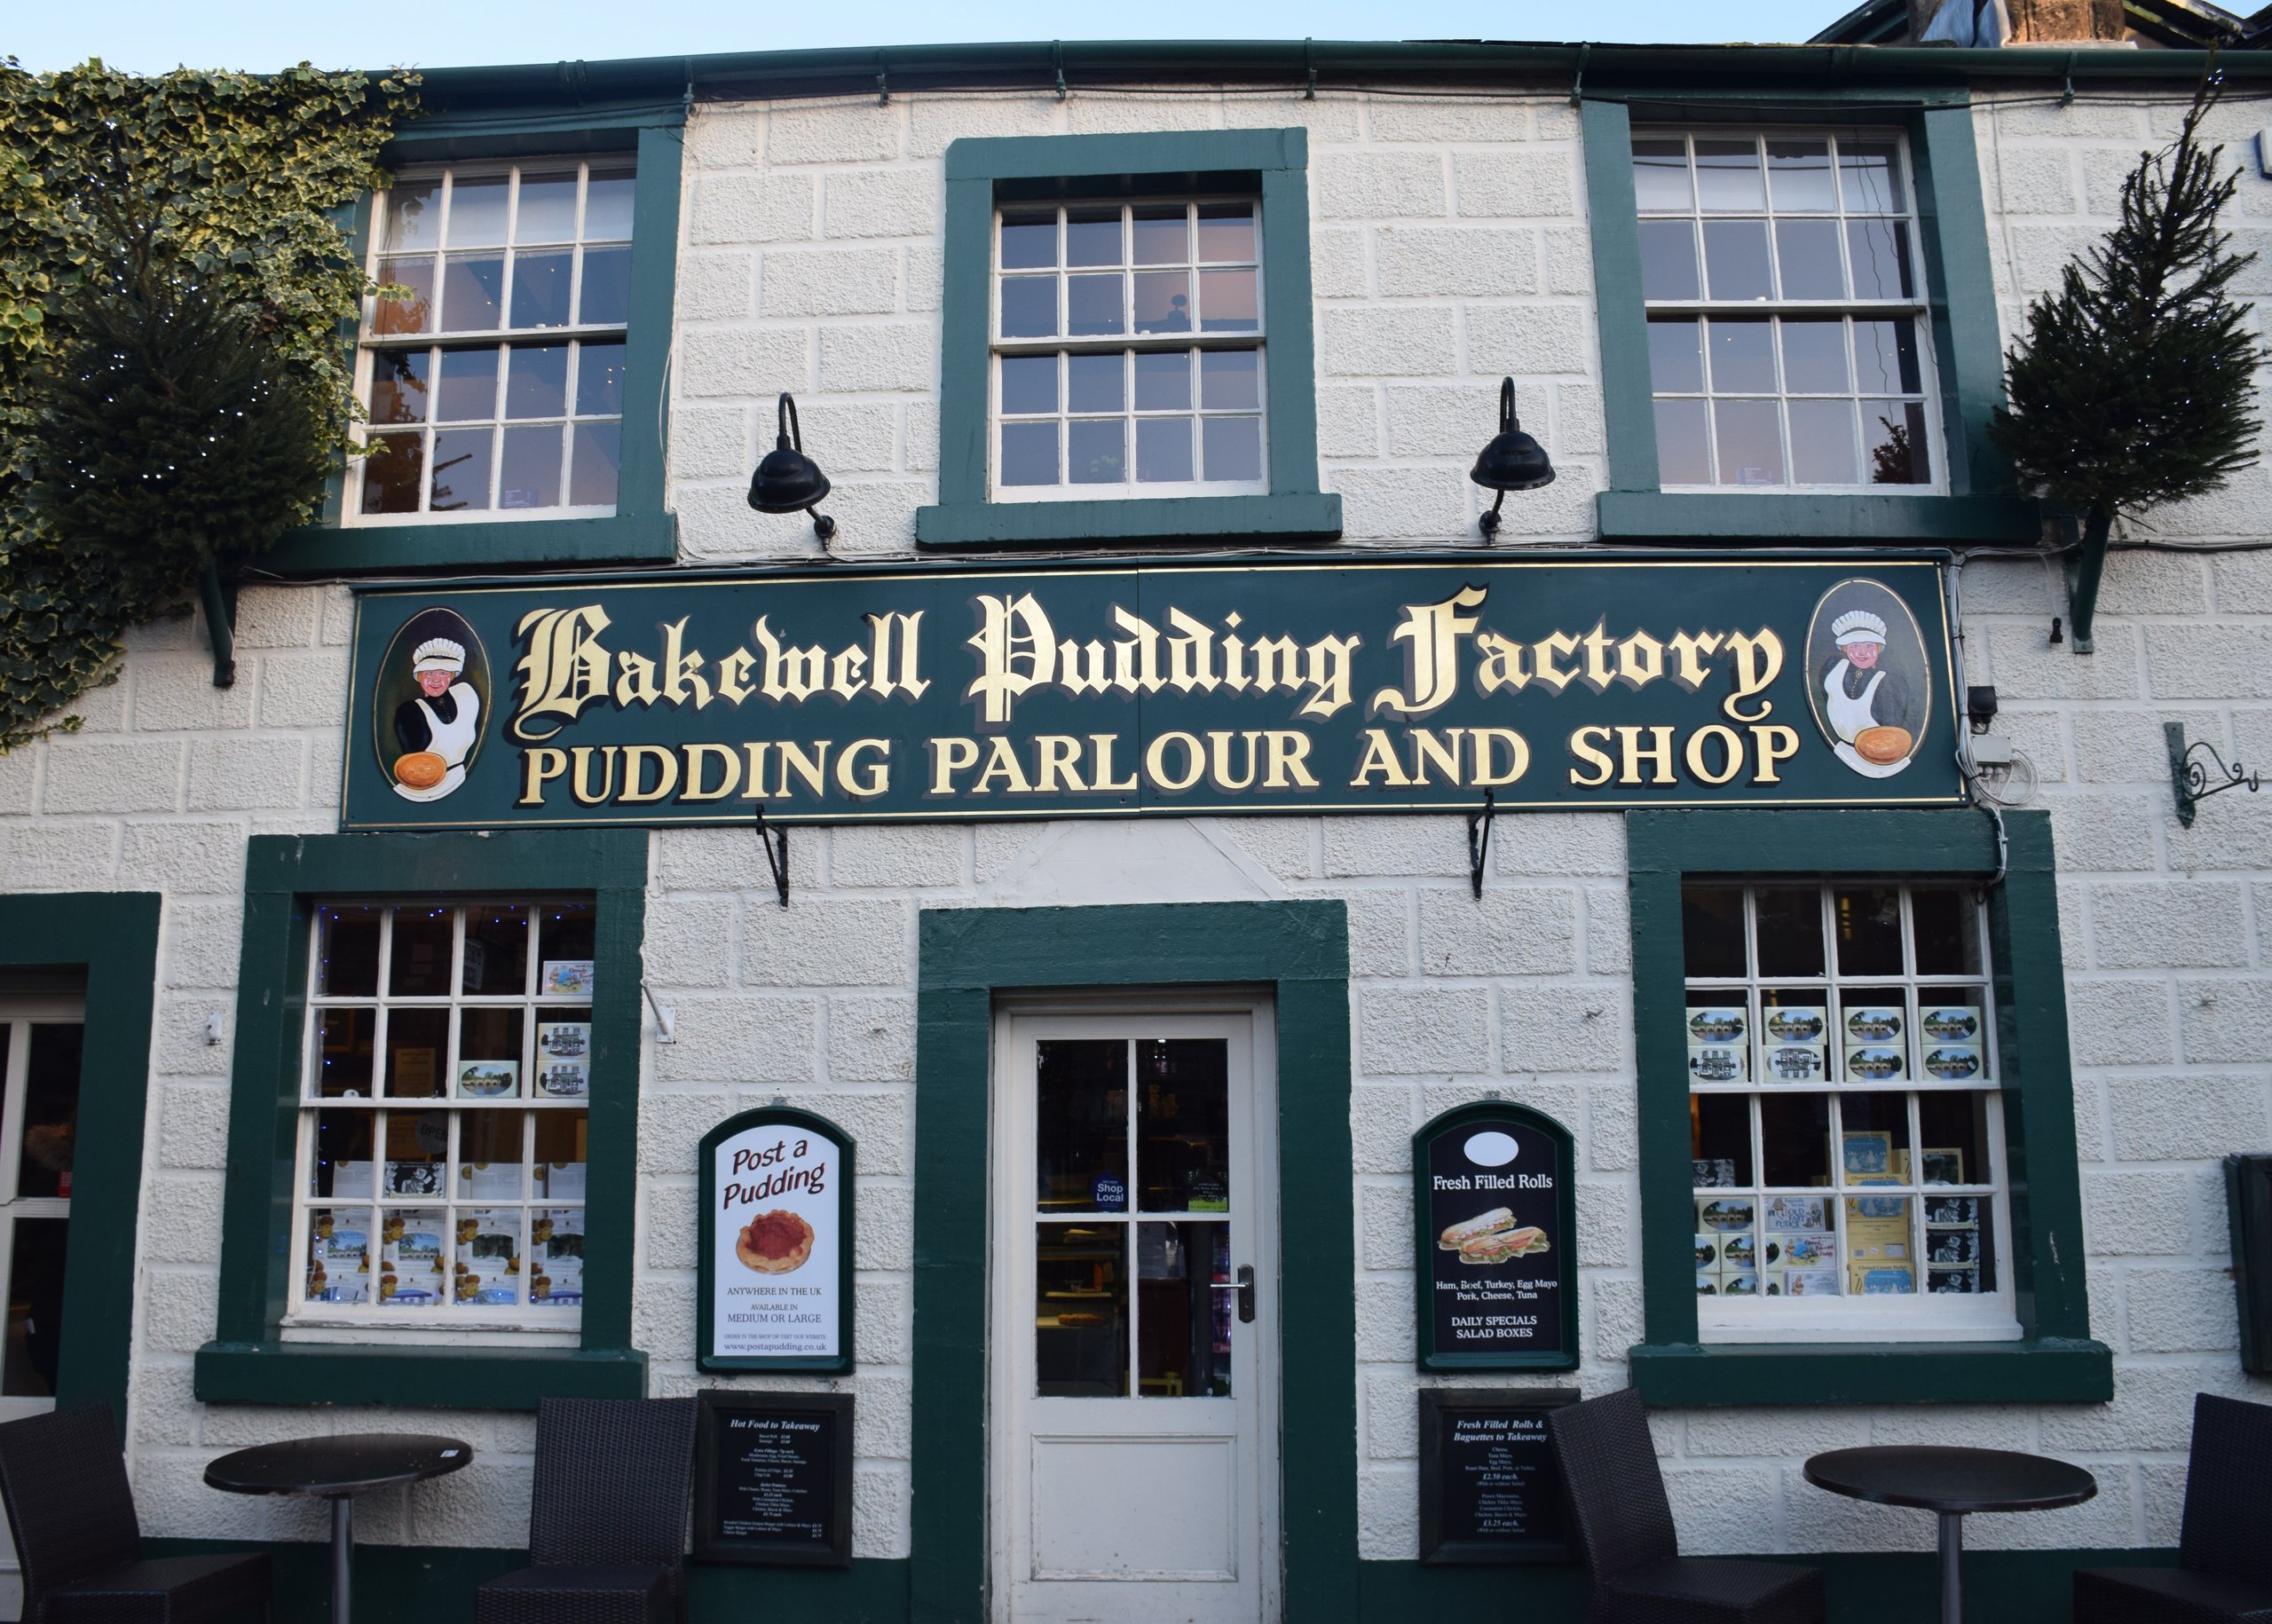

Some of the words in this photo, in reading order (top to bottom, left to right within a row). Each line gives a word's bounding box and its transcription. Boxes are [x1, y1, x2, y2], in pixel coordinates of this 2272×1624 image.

[515, 603, 932, 741] Bakewell
[966, 592, 1364, 723] Pudding
[1373, 583, 1783, 722] Factory
[519, 738, 890, 804] PUDDING
[931, 730, 1321, 795] PARLOUR
[1351, 728, 1530, 788] AND
[1569, 724, 1800, 787] SHOP
[733, 1140, 787, 1176] Post
[793, 1139, 809, 1158] a
[723, 1163, 825, 1210] Pudding
[1433, 1176, 1471, 1190] Fresh
[1475, 1175, 1515, 1189] Filled
[1519, 1174, 1553, 1188] Rolls
[1097, 1183, 1124, 1194] Shop
[1097, 1193, 1124, 1202] Local
[1436, 1281, 1459, 1291] Ham,
[1461, 1281, 1483, 1290] Beef,
[1485, 1281, 1516, 1291] Turkey,
[1518, 1281, 1534, 1290] Egg
[1535, 1280, 1558, 1289] Mayo
[1457, 1292, 1479, 1301] Pork,
[1481, 1291, 1515, 1301] Cheese,
[728, 1314, 768, 1323] MEDIUM
[771, 1314, 785, 1323] OR
[788, 1314, 822, 1323] LARGE
[1452, 1317, 1484, 1327] DAILY
[1486, 1316, 1537, 1326] SPECIALS
[1456, 1329, 1495, 1339] SALAD
[1497, 1328, 1534, 1338] BOXES
[724, 1342, 827, 1352] www.postapudding.co.uk
[730, 1419, 747, 1429] Hot
[748, 1420, 769, 1429] Food
[770, 1421, 779, 1430] to
[781, 1421, 820, 1432] Takeaway
[1457, 1420, 1481, 1430] Fresh
[1484, 1420, 1509, 1430] Filled
[1512, 1420, 1534, 1430] Rolls
[1536, 1420, 1543, 1429] &
[1454, 1432, 1495, 1443] Baguettes
[1507, 1432, 1548, 1443] Takeaway
